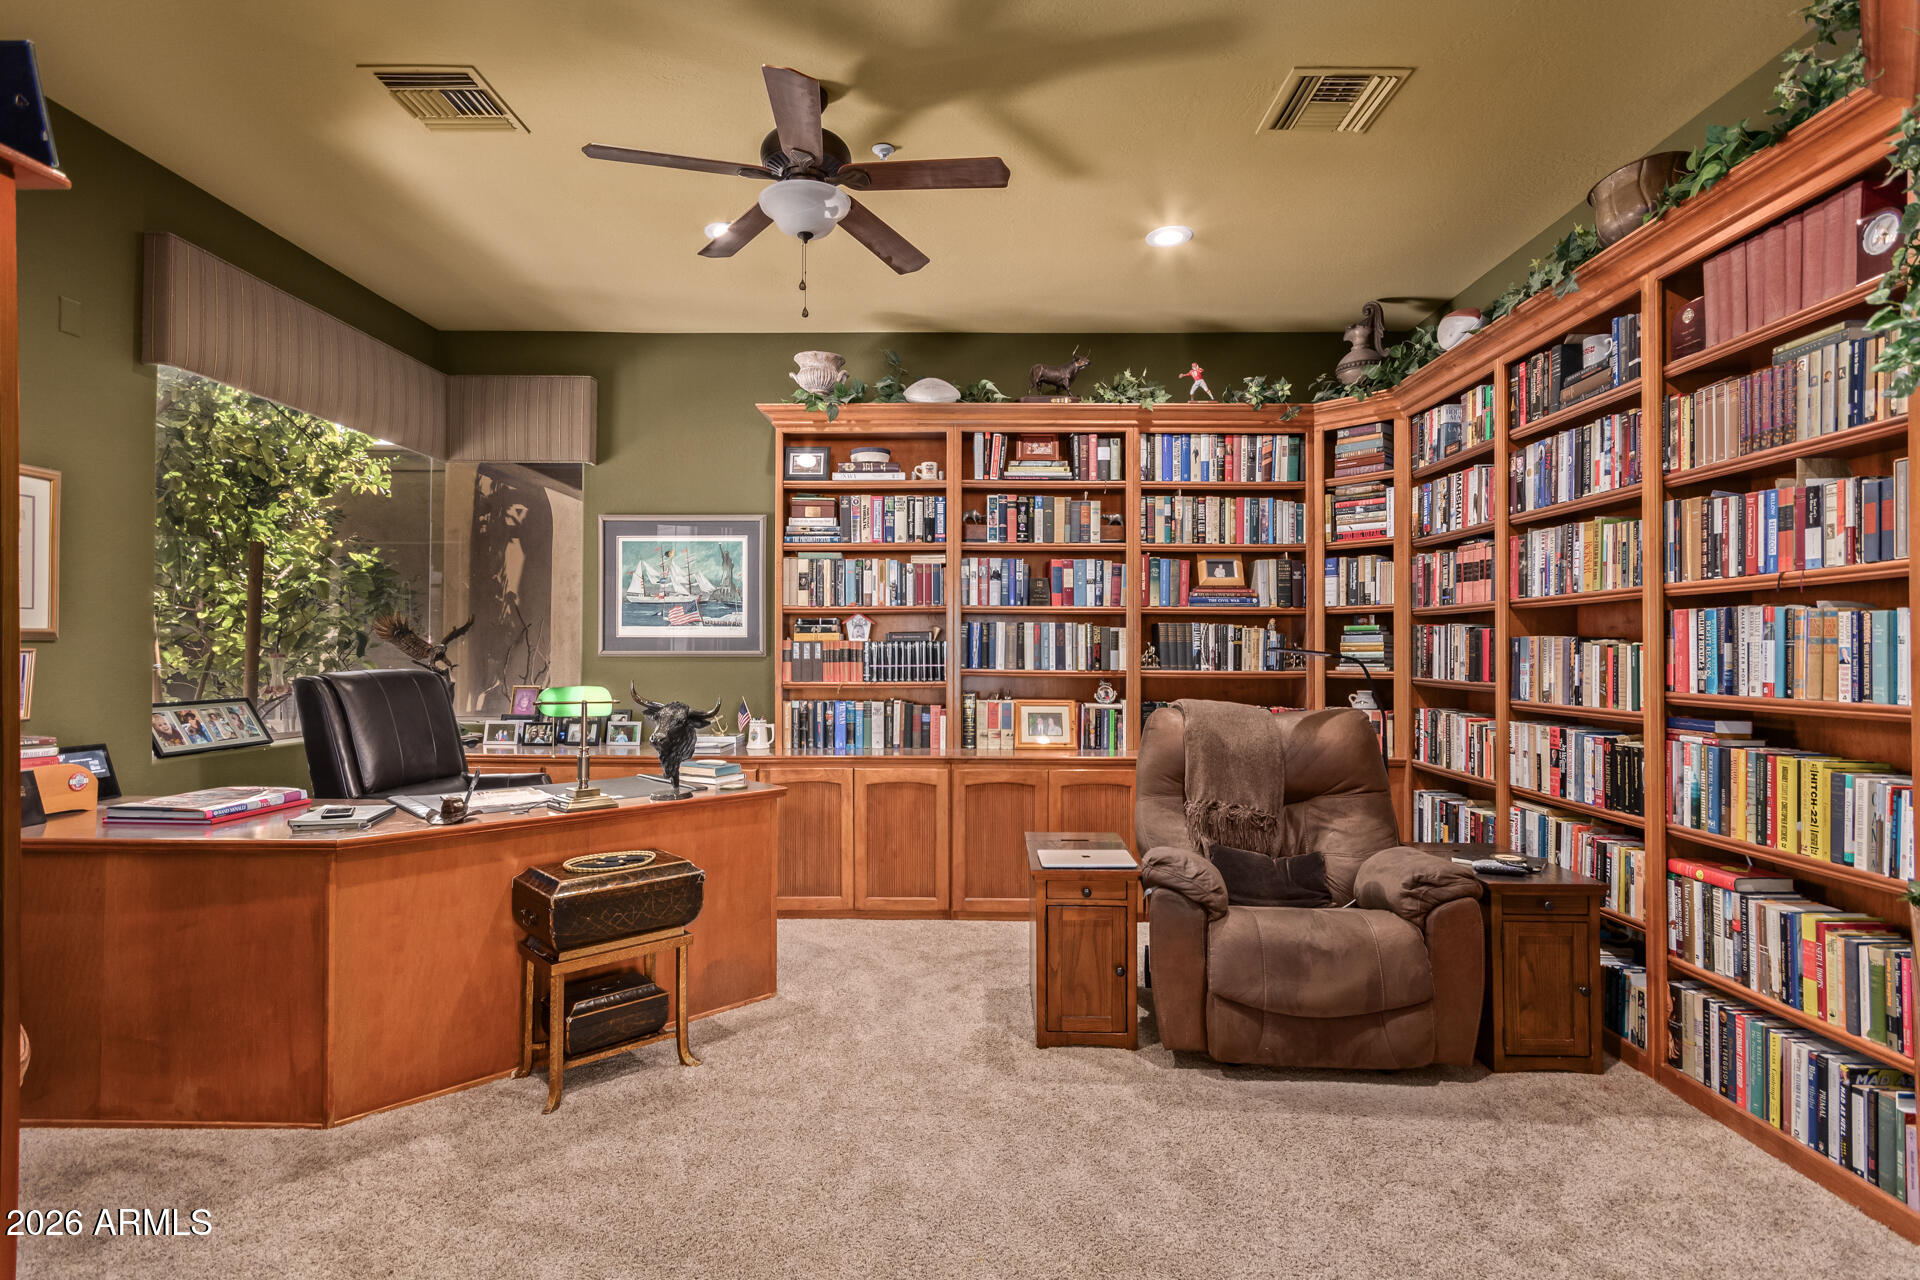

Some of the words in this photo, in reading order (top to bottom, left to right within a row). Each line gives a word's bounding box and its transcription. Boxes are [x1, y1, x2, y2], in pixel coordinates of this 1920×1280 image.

[1811, 773, 1819, 824] HITCH-22
[1885, 957, 1893, 972] gods
[1885, 981, 1893, 1007] begging
[1856, 1074, 1890, 1085] MAD
[1840, 1104, 1846, 1116] AS
